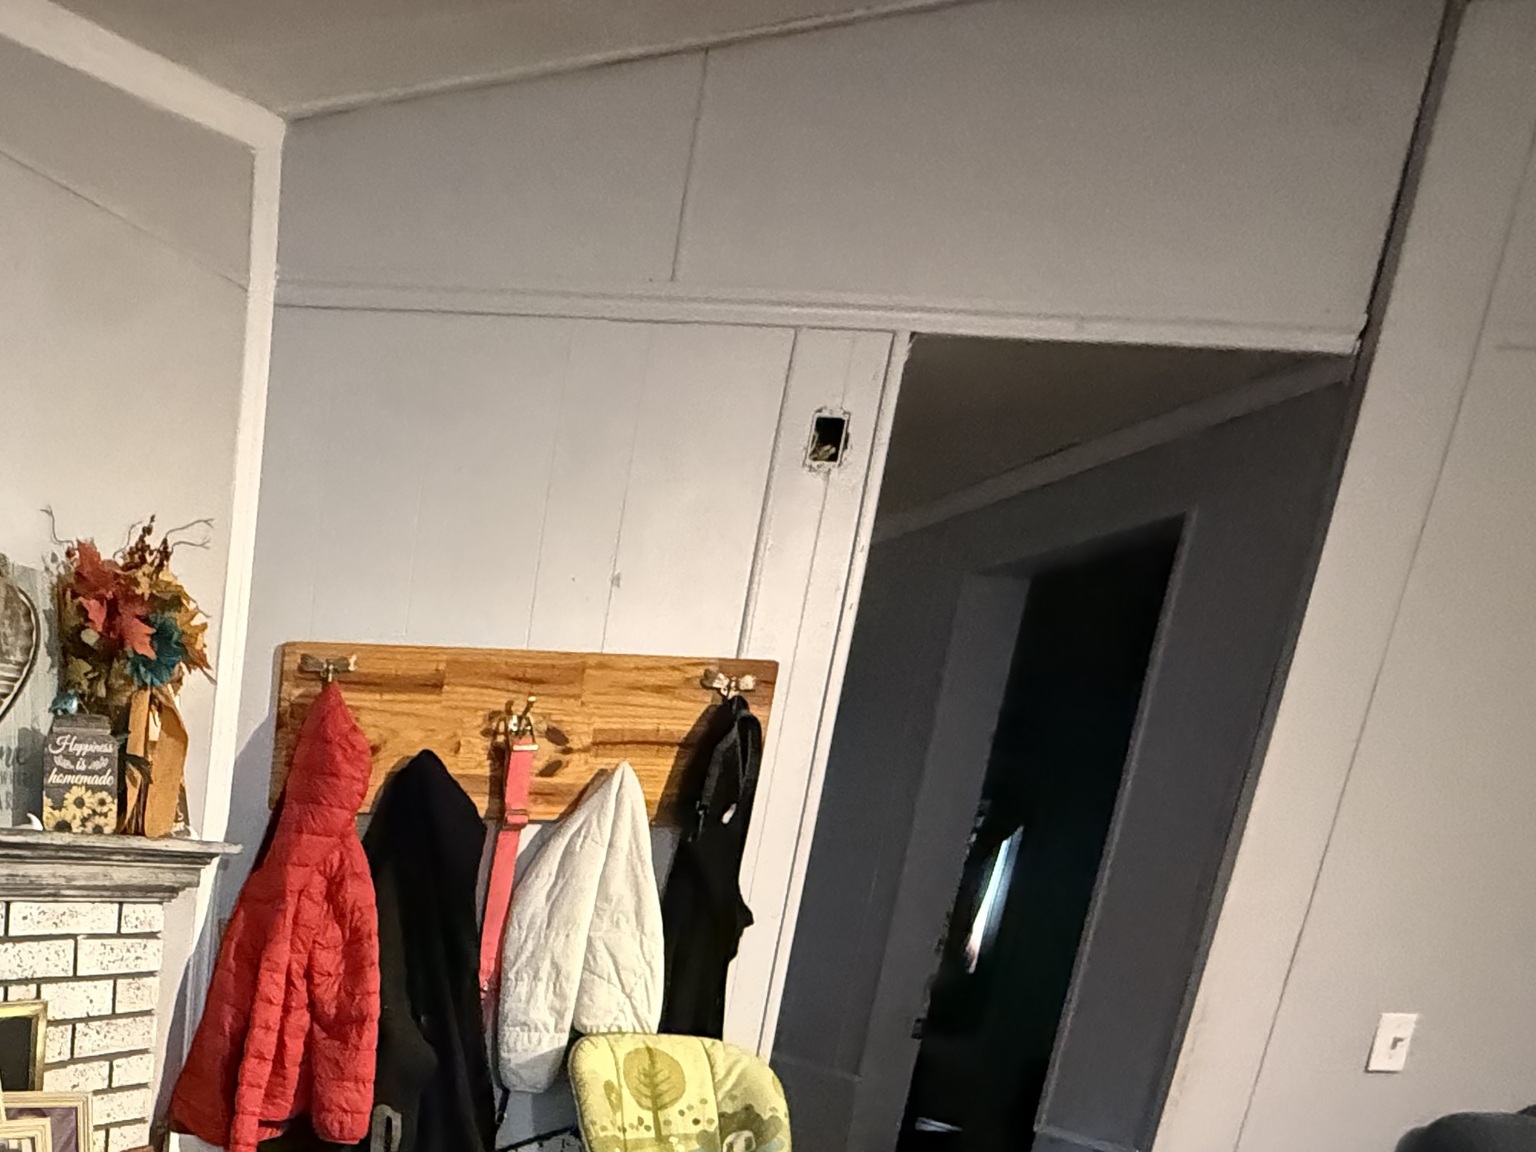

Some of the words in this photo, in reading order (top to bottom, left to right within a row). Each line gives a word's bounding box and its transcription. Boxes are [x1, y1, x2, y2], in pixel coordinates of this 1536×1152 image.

[48, 733, 114, 756] Happiness
[75, 756, 87, 771] is
[47, 769, 115, 786] homemade
